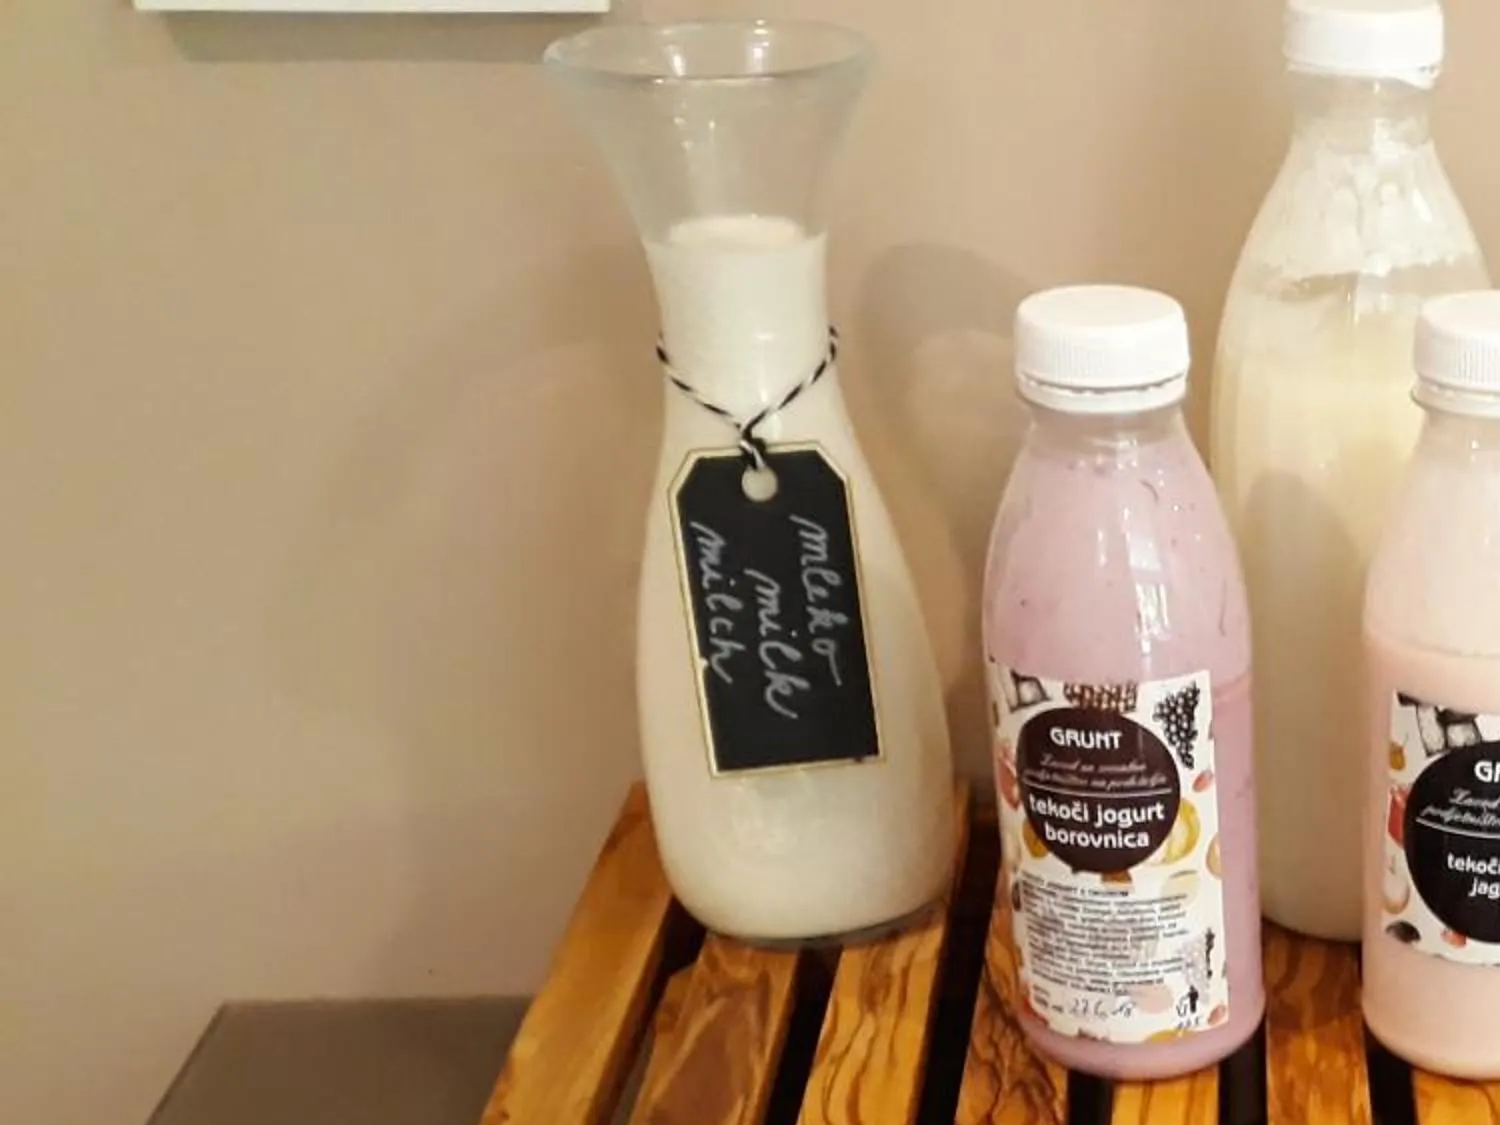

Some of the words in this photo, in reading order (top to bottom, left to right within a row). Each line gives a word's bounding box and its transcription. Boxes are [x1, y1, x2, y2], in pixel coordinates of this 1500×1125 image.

[689, 521, 747, 684] milch
[744, 568, 811, 720] milk
[789, 514, 850, 687] mleko
[1050, 727, 1123, 750] GRUNT
[1028, 793, 1090, 823] tekoči
[1094, 802, 1166, 829] jogurt
[1044, 821, 1150, 849] borovnica
